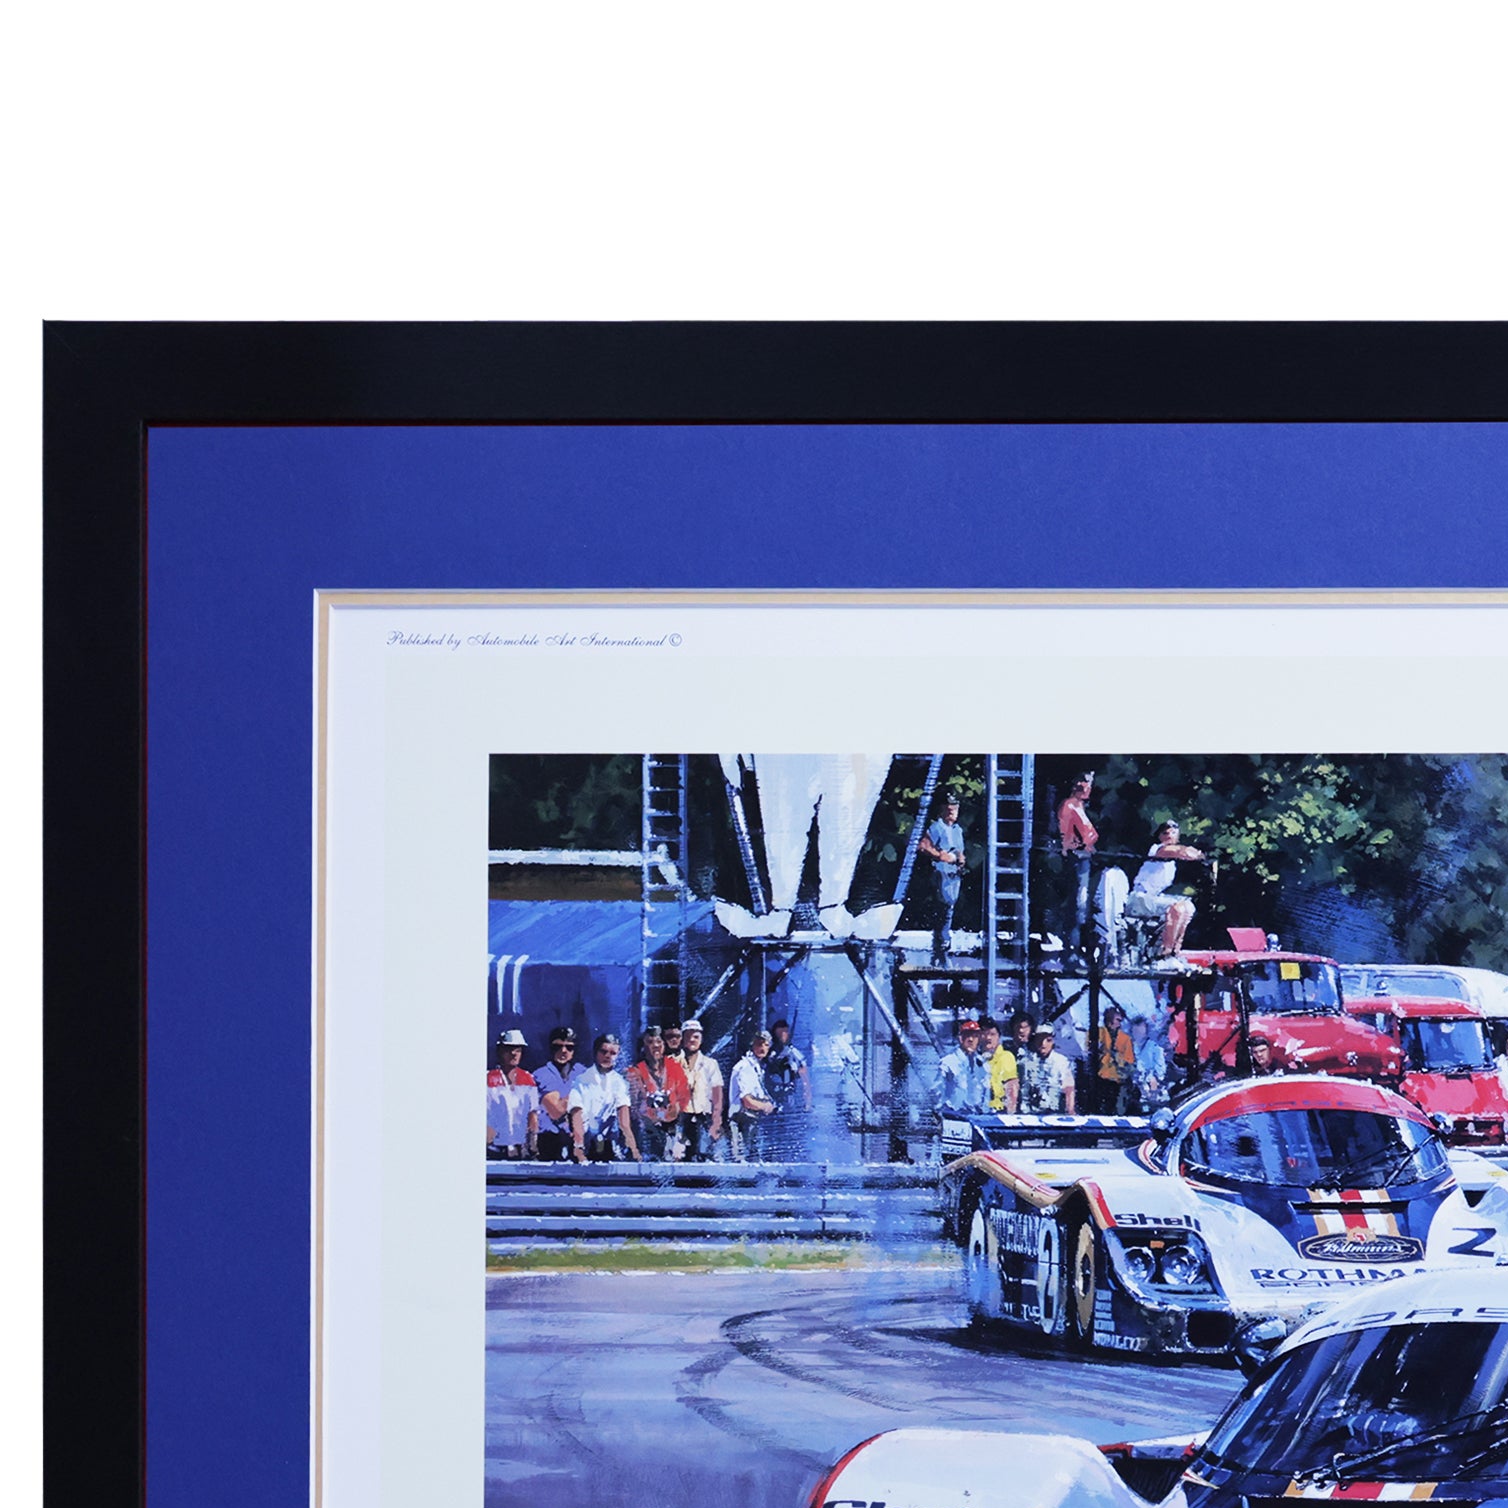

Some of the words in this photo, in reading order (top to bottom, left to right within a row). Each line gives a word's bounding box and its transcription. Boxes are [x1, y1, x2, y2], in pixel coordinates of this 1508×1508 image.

[386, 630, 444, 646] Published
[448, 632, 461, 651] by
[467, 632, 540, 646] Automobile
[545, 632, 576, 646] Art
[580, 632, 665, 647] International
[1115, 1214, 1201, 1232] Shell
[1447, 1226, 1497, 1257] 2
